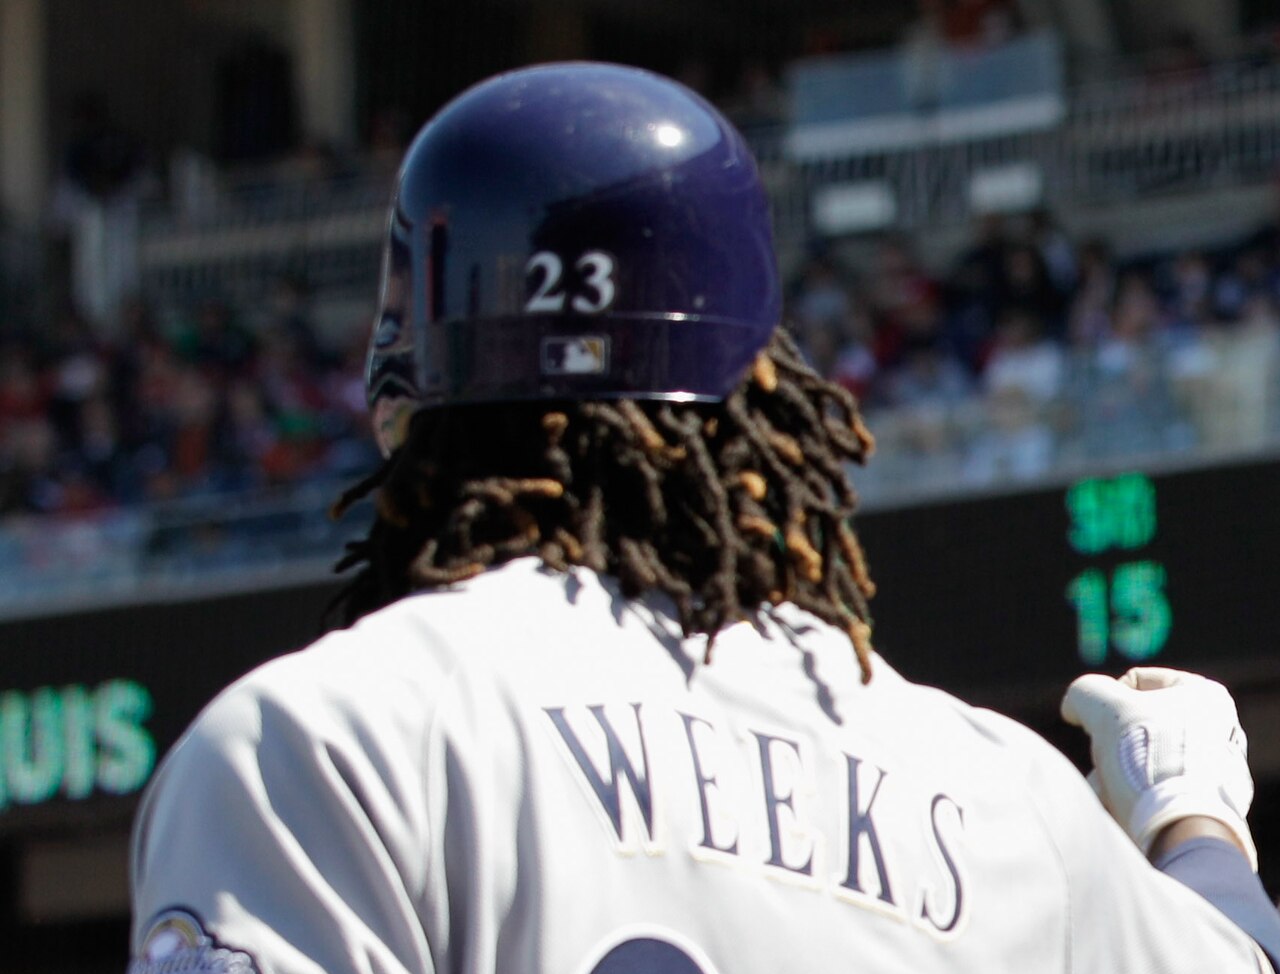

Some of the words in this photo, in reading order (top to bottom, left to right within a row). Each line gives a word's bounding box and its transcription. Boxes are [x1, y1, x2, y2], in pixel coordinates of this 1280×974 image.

[524, 249, 616, 313] 23
[1065, 561, 1172, 665] 15
[0, 678, 157, 812] UIS
[541, 701, 968, 937] WEEKS
